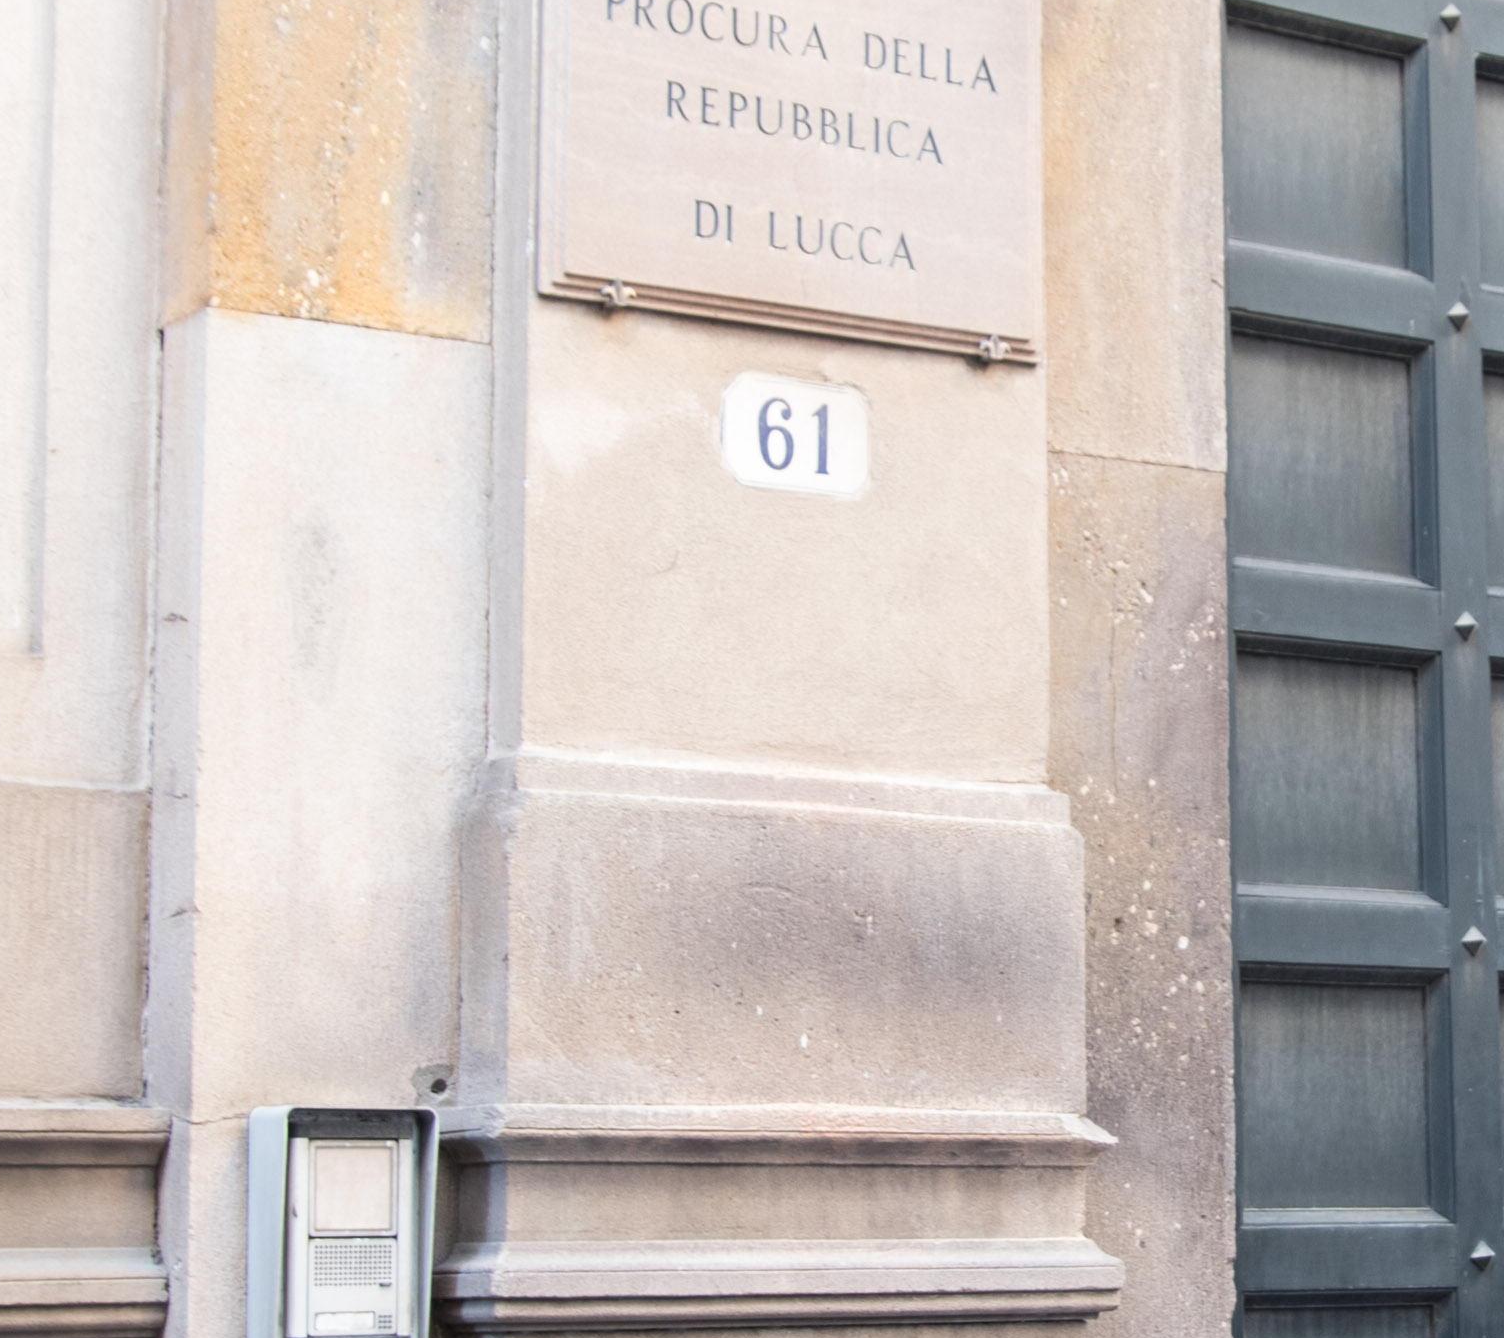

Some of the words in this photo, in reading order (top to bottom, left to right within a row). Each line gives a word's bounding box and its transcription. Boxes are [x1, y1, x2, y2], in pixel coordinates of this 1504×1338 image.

[863, 32, 998, 93] DELLA
[666, 80, 944, 165] REPUBBLICA
[695, 199, 734, 243] DI
[768, 211, 917, 271] LUCCA
[758, 397, 830, 475] 61
